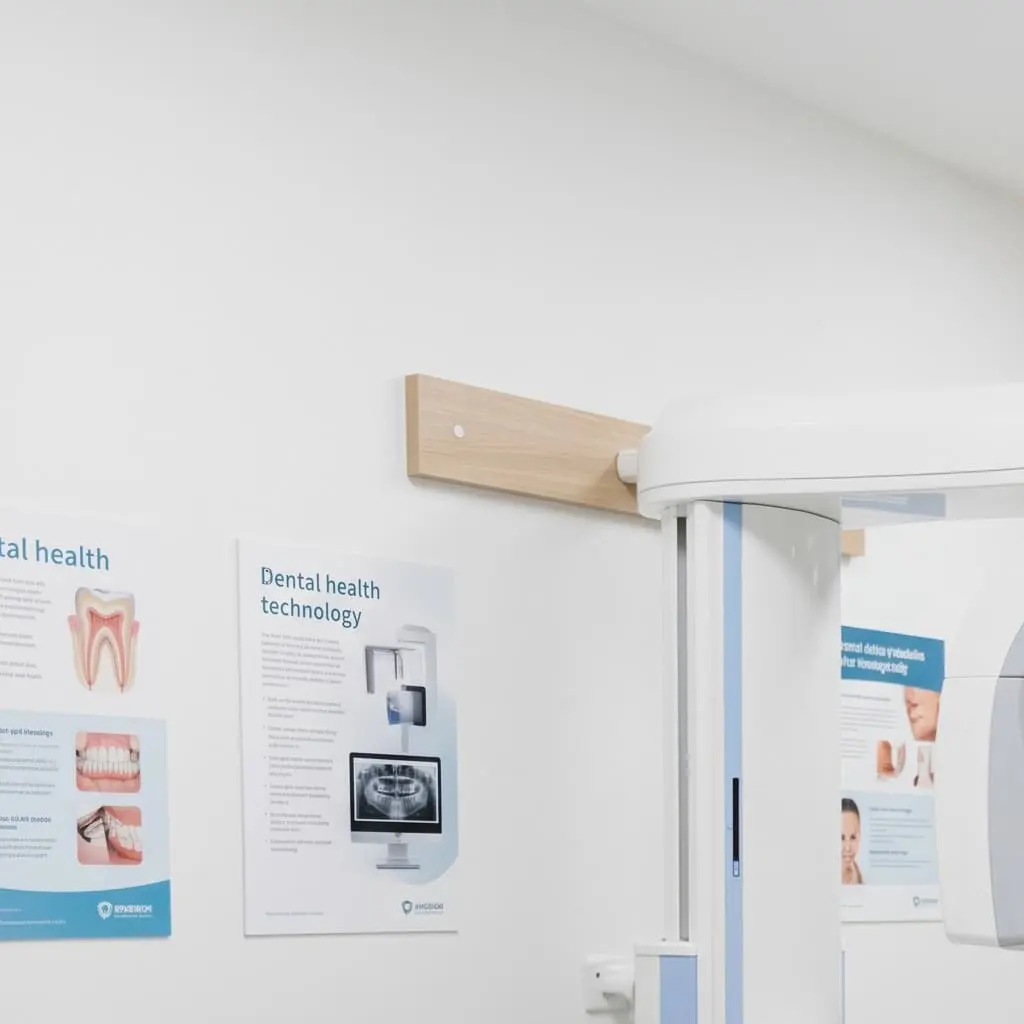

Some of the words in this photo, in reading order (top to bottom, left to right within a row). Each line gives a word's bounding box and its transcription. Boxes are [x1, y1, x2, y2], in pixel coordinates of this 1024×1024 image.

[35, 539, 110, 572] health
[260, 566, 321, 593] Dental
[326, 573, 380, 600] health
[260, 596, 362, 630] technology
